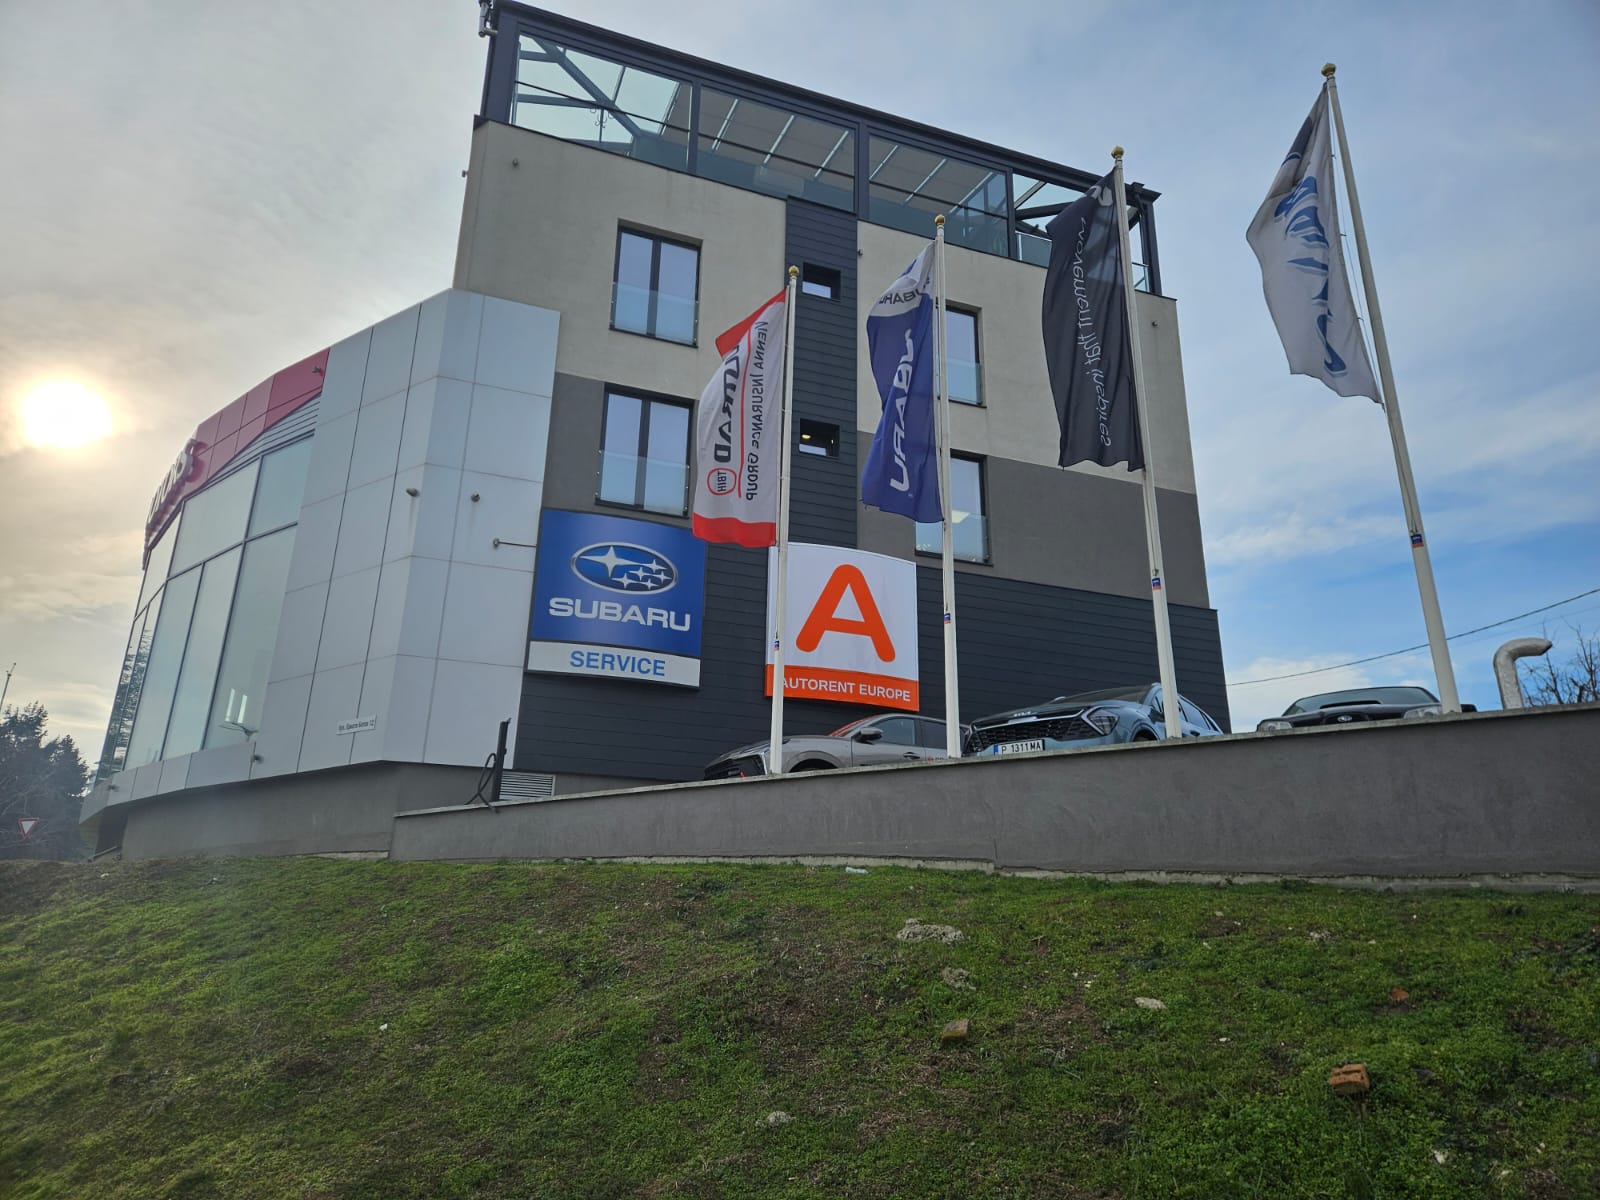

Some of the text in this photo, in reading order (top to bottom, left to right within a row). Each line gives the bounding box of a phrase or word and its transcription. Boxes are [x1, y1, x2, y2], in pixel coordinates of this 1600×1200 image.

[549, 597, 691, 632] SUBARU
[796, 564, 895, 662] A
[570, 651, 666, 677] SERVICE
[783, 677, 911, 702] AUTORENT EUROPE
[1011, 743, 1029, 753] 1311
